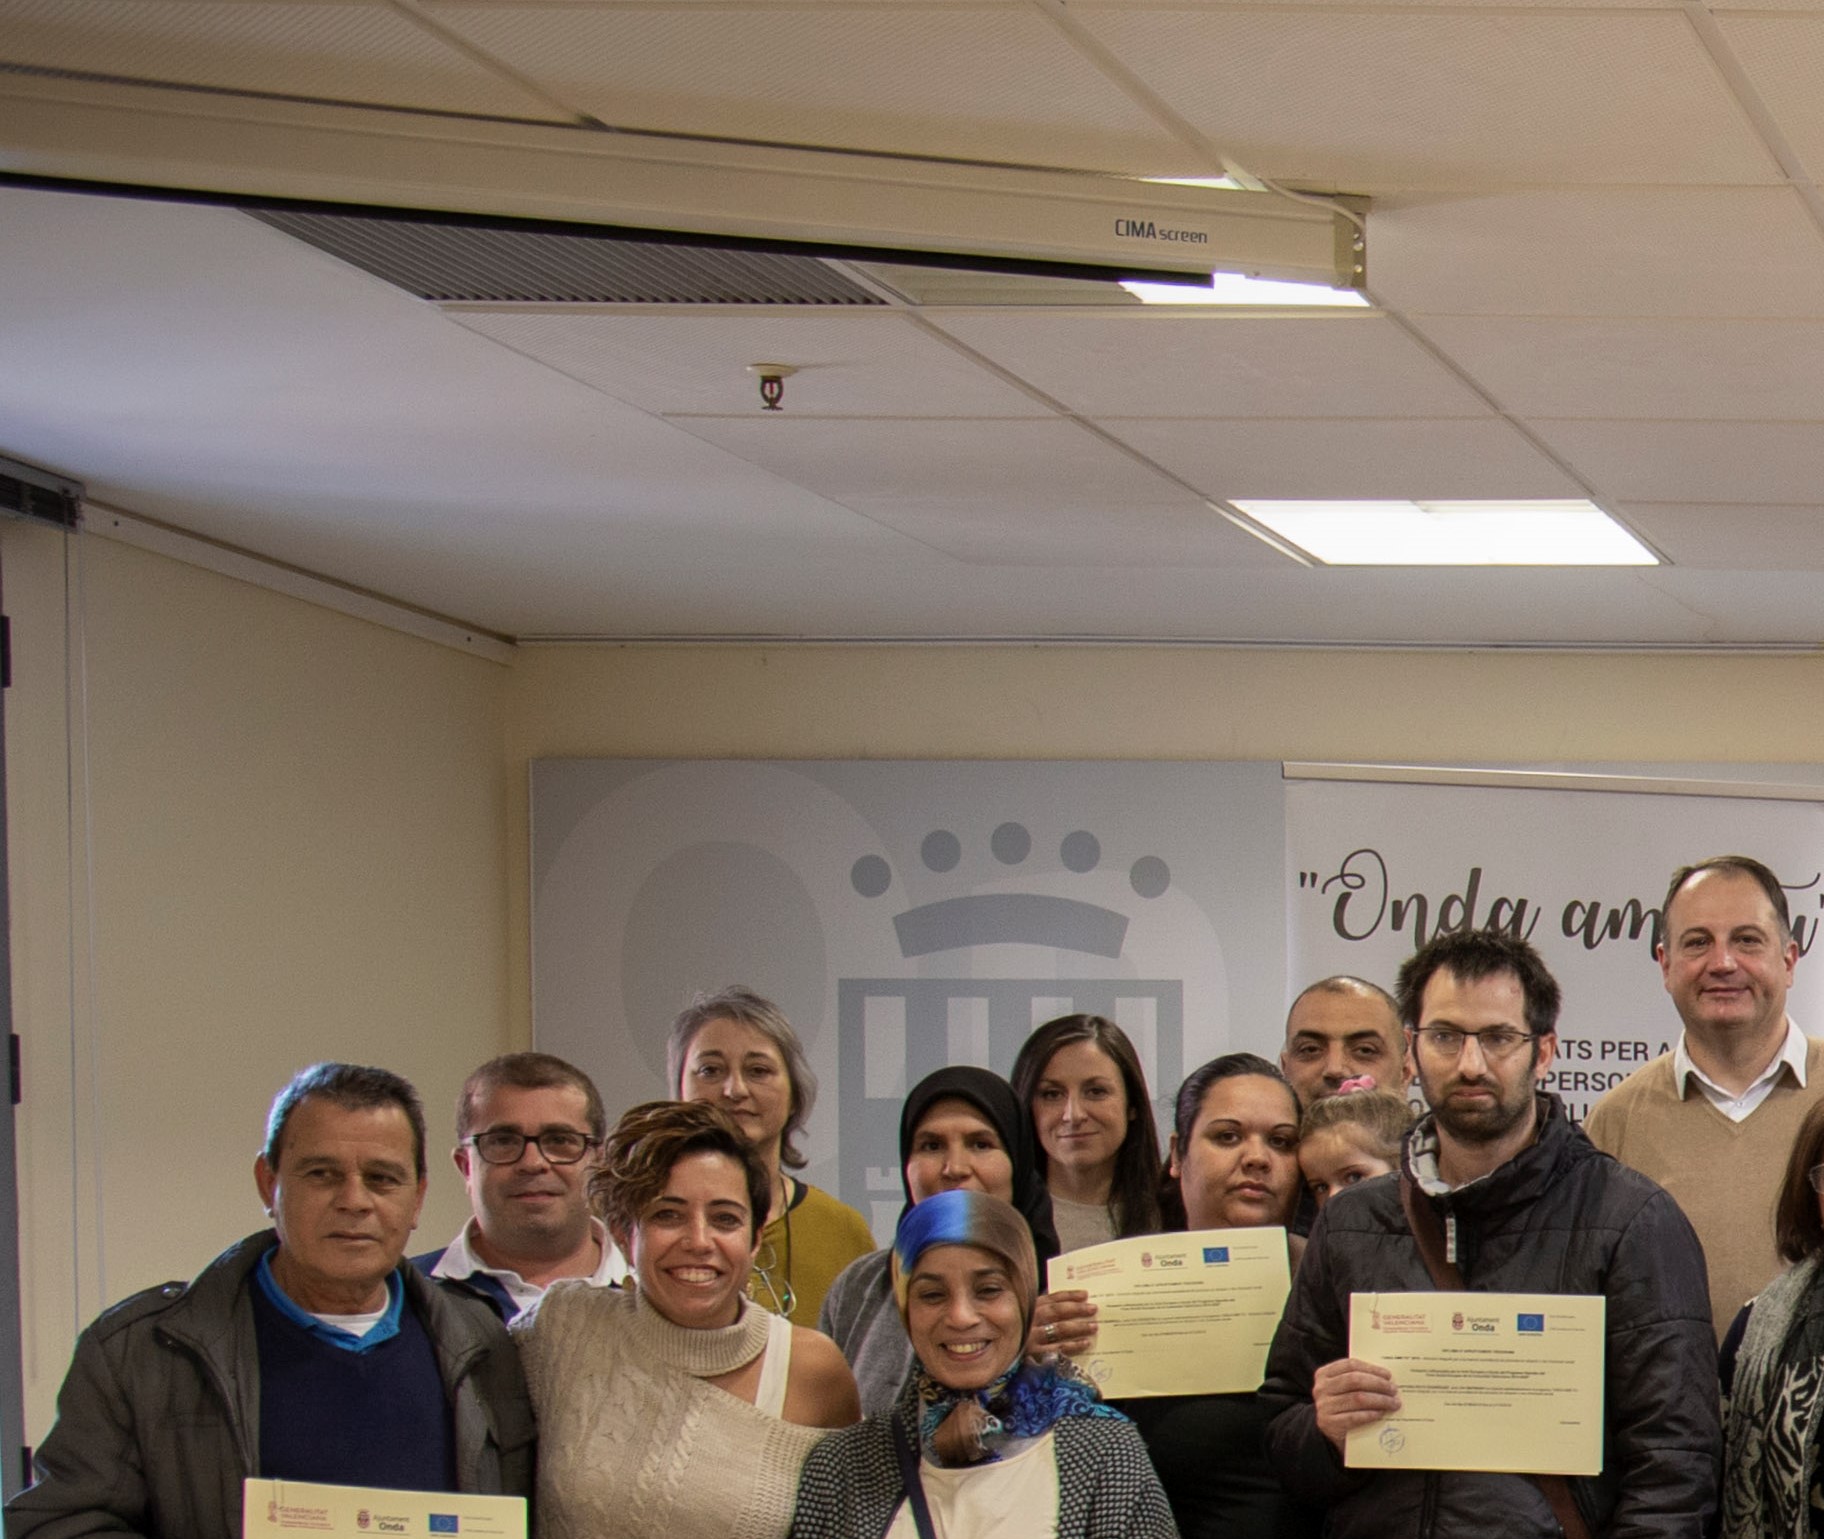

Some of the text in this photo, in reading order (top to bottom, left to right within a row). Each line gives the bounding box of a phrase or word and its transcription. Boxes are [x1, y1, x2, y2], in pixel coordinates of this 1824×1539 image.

[1114, 218, 1208, 244] CIMA screen
[1562, 898, 1663, 962] am
[1601, 1040, 1648, 1061] PER
[1471, 1323, 1496, 1333] Onda
[378, 1521, 405, 1532] Onda
